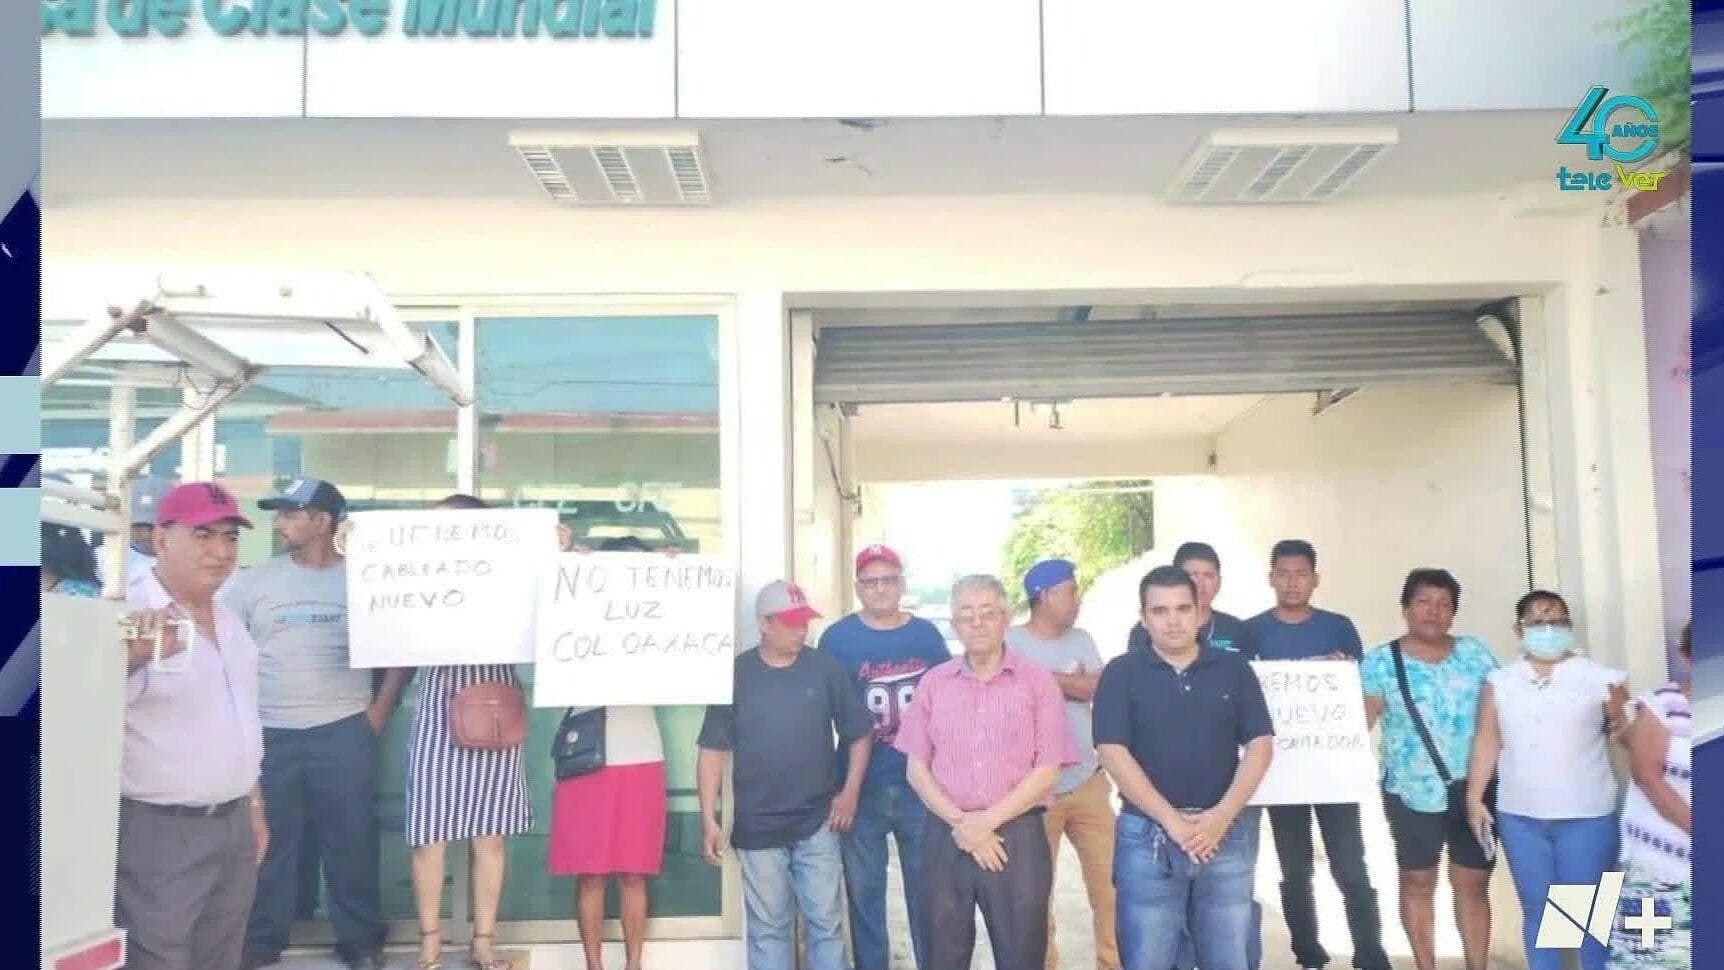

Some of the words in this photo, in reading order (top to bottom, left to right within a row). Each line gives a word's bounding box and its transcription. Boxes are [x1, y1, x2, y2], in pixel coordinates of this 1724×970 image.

[553, 564, 607, 603] NO
[368, 586, 466, 616] NUEVO
[602, 600, 664, 621] LUZ
[552, 631, 608, 663] COL
[621, 630, 734, 657] OAXACA
